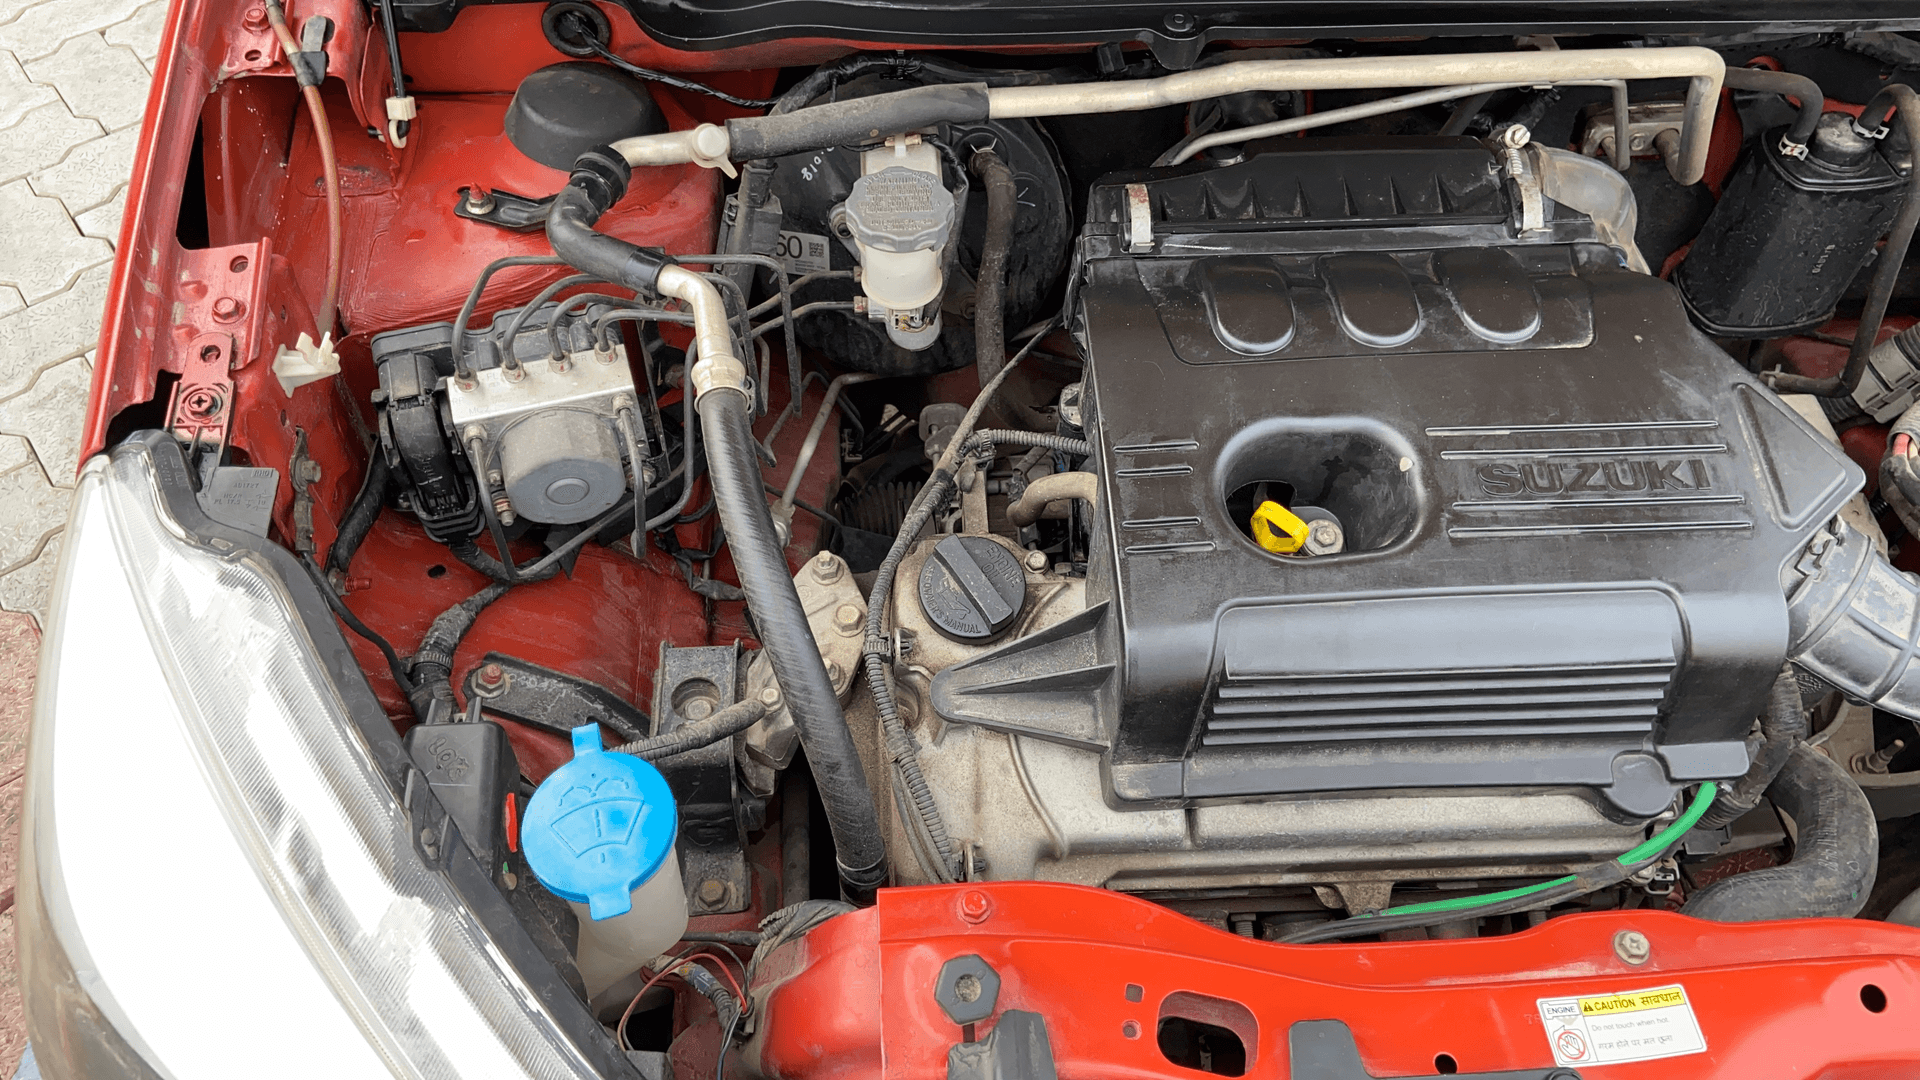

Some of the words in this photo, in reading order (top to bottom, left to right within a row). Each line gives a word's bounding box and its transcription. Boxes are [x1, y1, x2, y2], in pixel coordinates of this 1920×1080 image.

[1477, 459, 1712, 497] SUZUKI
[985, 544, 1023, 588] ENGINE
[944, 616, 982, 634] MANUAL
[1594, 998, 1636, 1011] CAUTION
[1639, 991, 1682, 1006] सावधान
[1546, 1006, 1577, 1015] ENGINE
[1591, 1024, 1602, 1032] Do
[1603, 1023, 1615, 1031] not
[1615, 1021, 1635, 1030] touch
[1636, 1018, 1655, 1027] when
[1598, 1042, 1615, 1050] गरम
[1630, 1038, 1642, 1046] पर
[1643, 1036, 1656, 1045] मत
